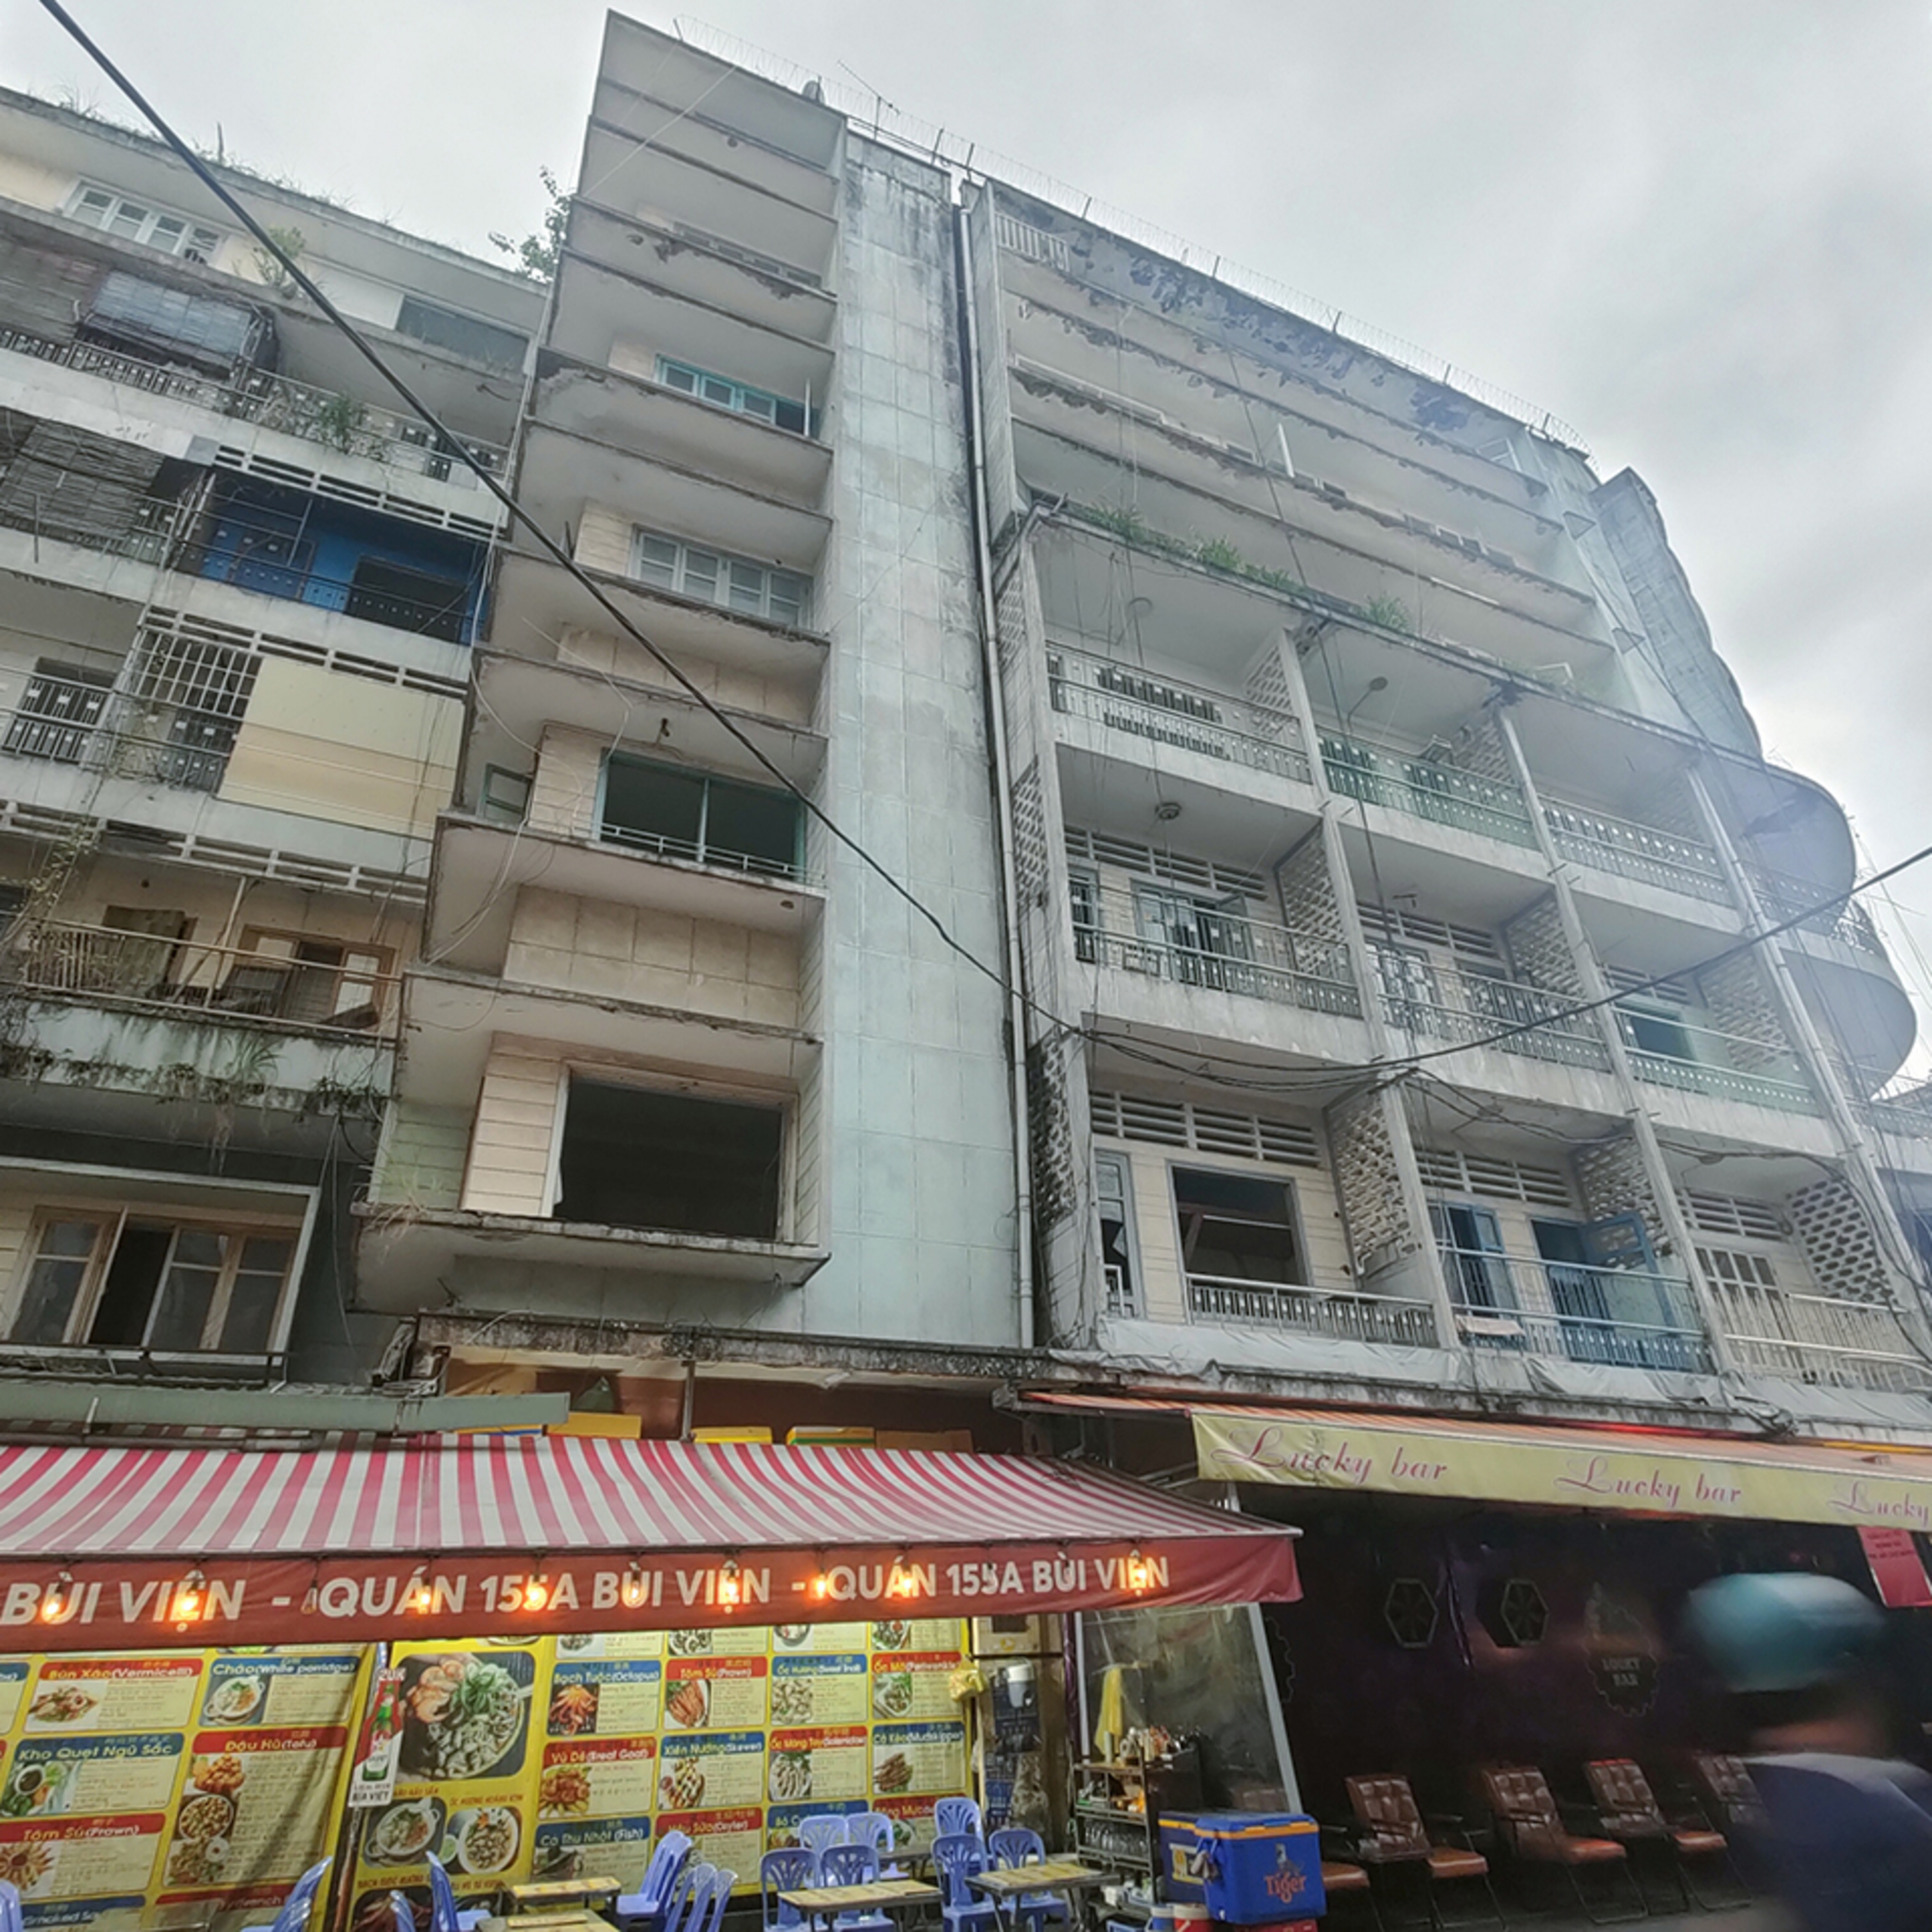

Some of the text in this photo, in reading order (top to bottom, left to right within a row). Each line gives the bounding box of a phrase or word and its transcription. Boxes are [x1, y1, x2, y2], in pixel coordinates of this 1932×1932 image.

[1211, 1426, 1447, 1483] Lucky bar
[1553, 1455, 1741, 1507] Lucky bar
[1826, 1481, 1929, 1528] Lucky
[0, 1571, 102, 1625] BÙI
[120, 1570, 247, 1632] VIỆN
[319, 1566, 467, 1618] QUÁN
[480, 1573, 580, 1612] 155A
[592, 1560, 663, 1609] BÙI
[676, 1559, 770, 1614] VIỆN
[827, 1556, 936, 1601] QUÁN
[946, 1562, 1025, 1596] 155A
[1033, 1551, 1087, 1593] BÙI
[1095, 1549, 1170, 1596] VIỆN
[1264, 1871, 1307, 1904] Tiger
